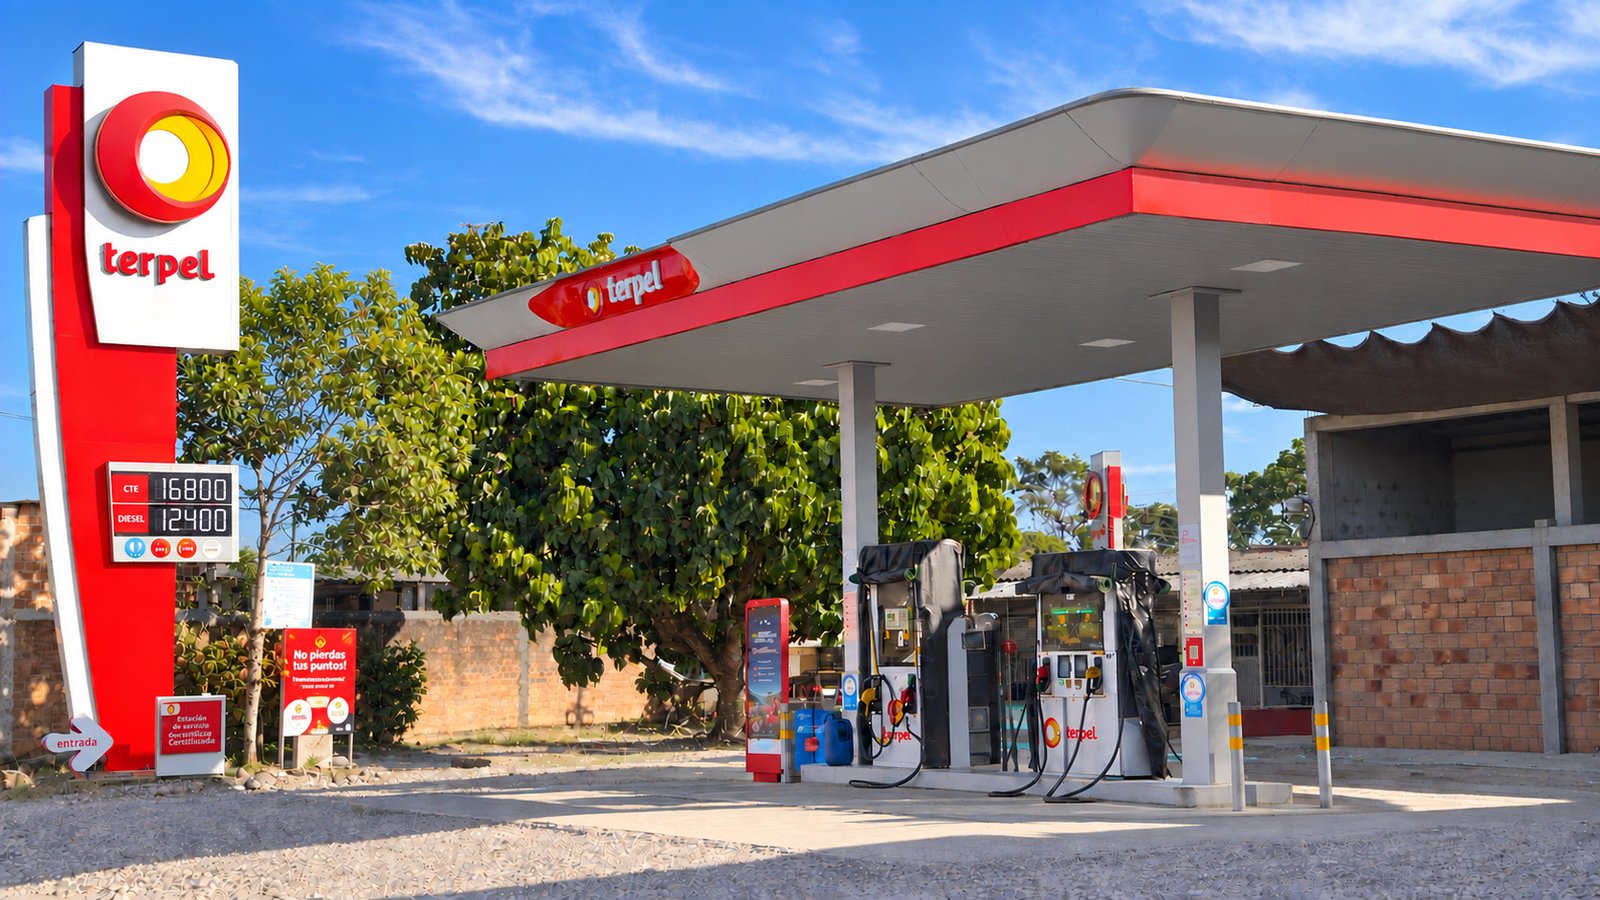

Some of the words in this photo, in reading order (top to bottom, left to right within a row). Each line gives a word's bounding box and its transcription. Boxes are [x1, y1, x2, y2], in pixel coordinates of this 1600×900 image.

[102, 242, 215, 284] terpel
[607, 260, 663, 305] terpel
[123, 485, 139, 493] CTE
[163, 478, 226, 500] 16800
[117, 515, 145, 523] DIESEL
[163, 508, 226, 531] 12400
[293, 650, 308, 660] No
[310, 649, 346, 662] pierdas
[293, 661, 308, 671] tus
[310, 660, 347, 673] puntos!
[56, 737, 98, 748] entrada
